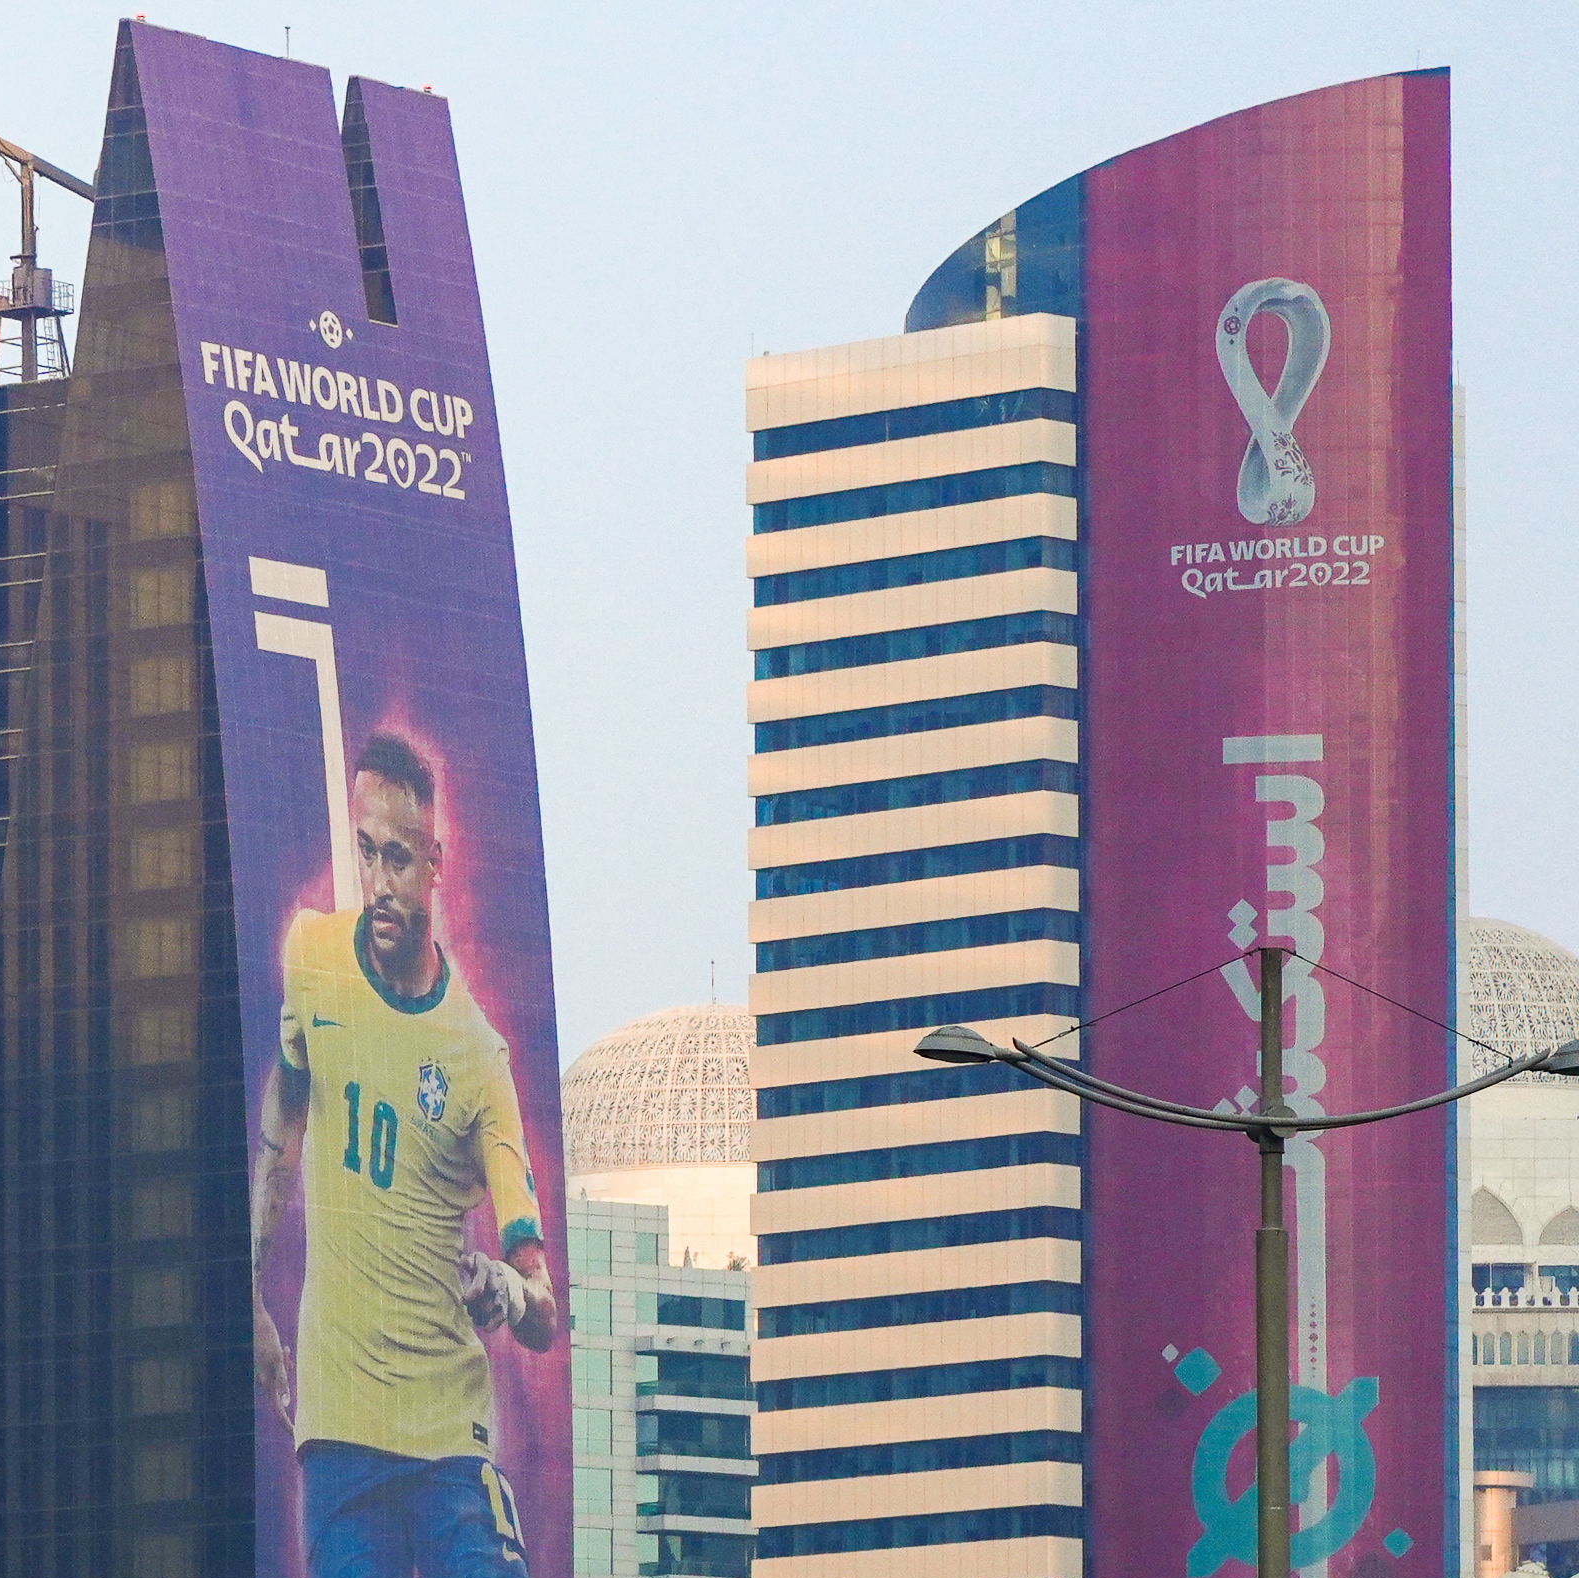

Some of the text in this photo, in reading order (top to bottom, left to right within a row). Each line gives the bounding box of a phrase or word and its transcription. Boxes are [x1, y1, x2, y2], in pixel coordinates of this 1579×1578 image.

[200, 341, 474, 439] FIFA WORLD CUP
[223, 400, 467, 500] Qatar2022
[1170, 534, 1385, 566] FIFA WORLD CUP
[1181, 561, 1371, 599] Qatar2022
[343, 1081, 397, 1190] 10
